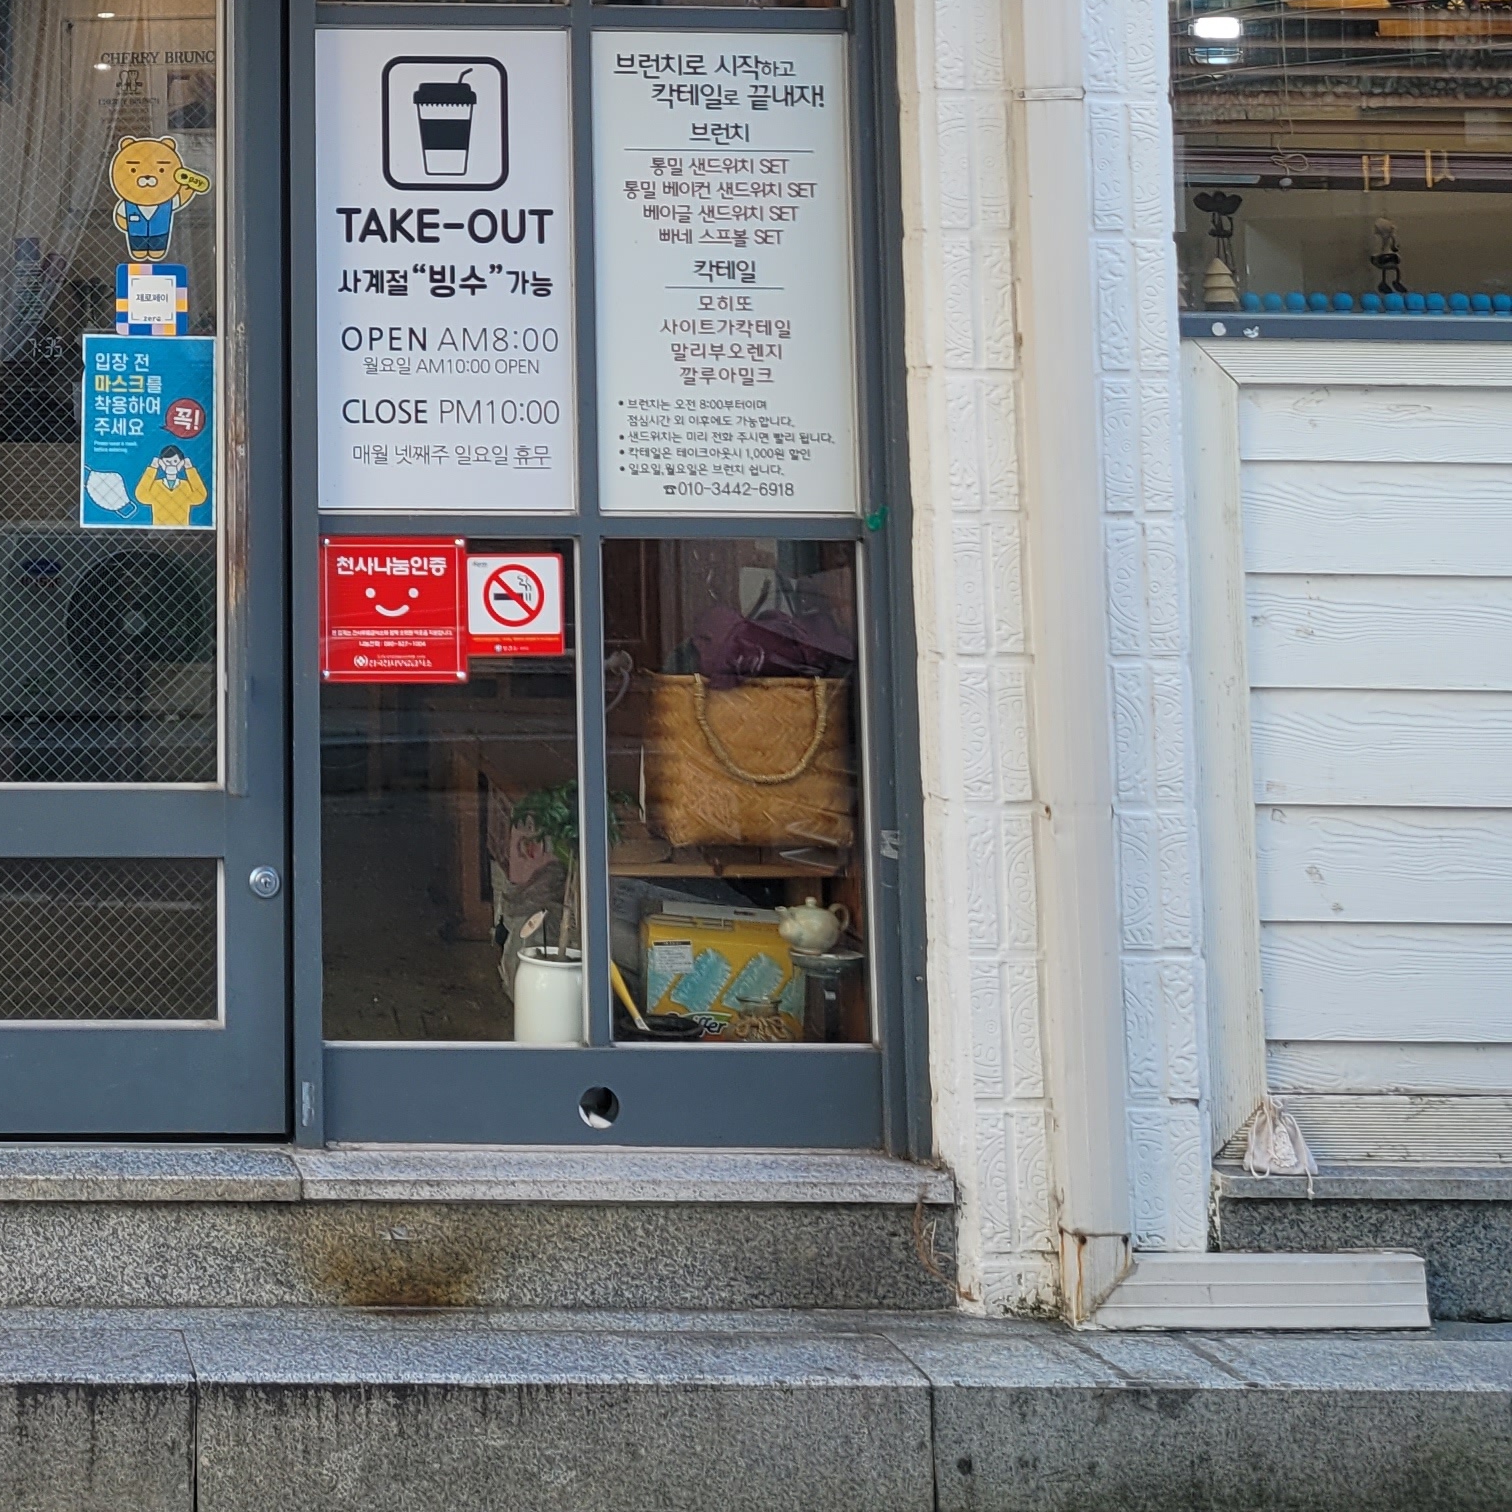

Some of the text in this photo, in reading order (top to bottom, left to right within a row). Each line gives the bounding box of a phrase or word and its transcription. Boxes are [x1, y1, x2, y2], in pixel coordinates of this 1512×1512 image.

[101, 51, 160, 65] CHERRY
[613, 53, 797, 80] 브런치로 시작하고
[651, 83, 825, 110] 칵테일로 끝내자!
[689, 123, 750, 145] 브런치
[650, 157, 790, 176] 통밀 샌드위치 SET
[623, 181, 817, 200] 통밀 베이컨 샌드위치 SET
[643, 204, 799, 223] 베이글 샌드위치 SET
[336, 207, 554, 244] TAKE-OUT
[659, 228, 784, 248] 빠네 스프볼 SET
[693, 260, 756, 283] 칵테일
[136, 293, 168, 303] 제로페이
[697, 295, 753, 312] 모히또
[341, 326, 559, 352] OPEN AM8:00
[671, 343, 783, 361] 말리부오렌지
[95, 352, 150, 372] 입장 전
[362, 356, 539, 375] 월요일 AM10:00 OPEN
[94, 375, 163, 394] 마스크를
[679, 367, 775, 386] 깔루아밀크
[94, 395, 161, 416] 착용하여
[342, 399, 560, 424] CLOSE PM10:00
[627, 399, 670, 410] 브런치는
[674, 399, 696, 411] 오전
[94, 417, 144, 437] 주세요
[173, 407, 200, 430] 꼭!
[627, 414, 670, 427] 점심시간
[688, 415, 733, 426] 이후에도
[628, 431, 683, 443] 샌드위치는
[686, 431, 707, 441] 미리
[711, 431, 733, 443] 전화
[352, 445, 552, 467] 매월 넷째주 일요일 휴무
[628, 447, 672, 459] 칵테일은
[712, 464, 744, 476] 브런치
[678, 481, 794, 496] 010-3442-6918
[337, 556, 448, 576] 천사나눔인증
